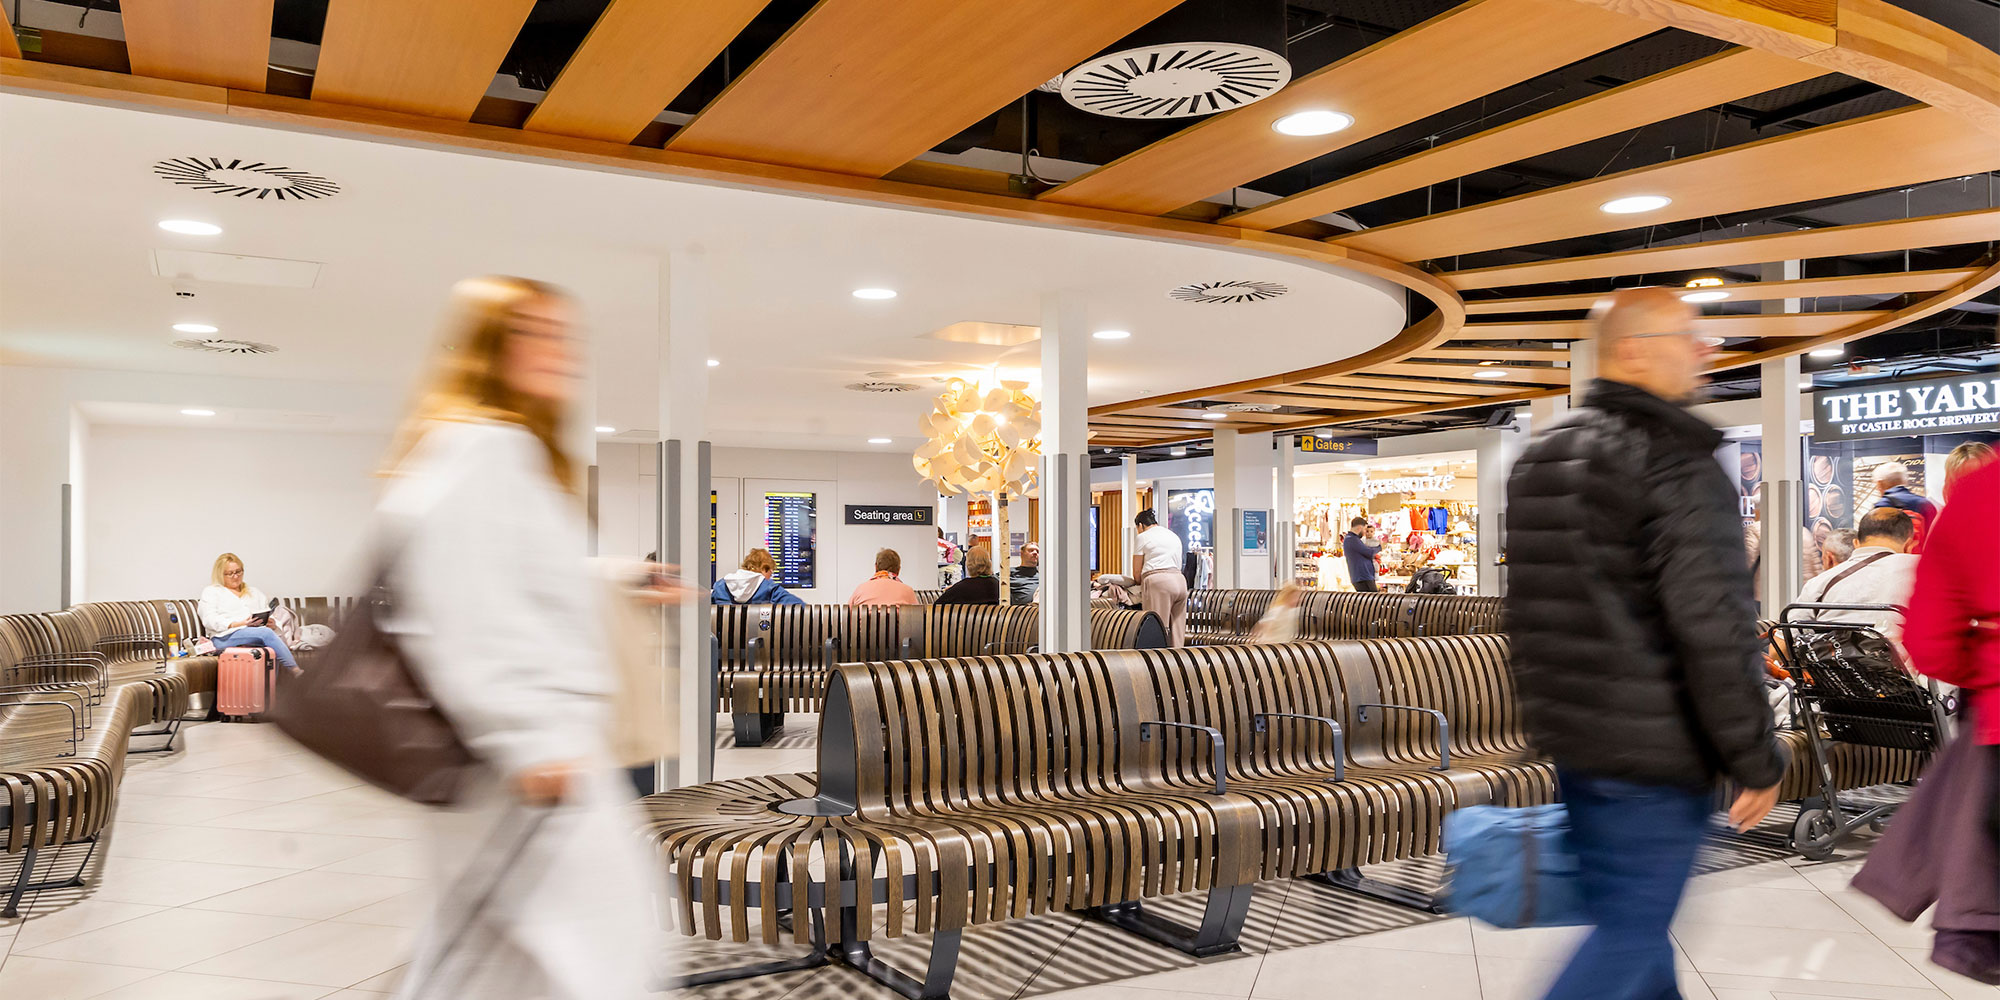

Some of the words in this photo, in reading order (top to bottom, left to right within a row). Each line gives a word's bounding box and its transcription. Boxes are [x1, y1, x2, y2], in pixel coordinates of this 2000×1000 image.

[1822, 389, 1902, 422] THE
[1842, 423, 1858, 434] BY
[1858, 419, 1901, 433] CASTLE
[1903, 416, 1937, 430] ROCK
[1938, 412, 2000, 427] BREWERY
[1315, 438, 1344, 451] Gates
[1357, 472, 1456, 500] Accessorize
[853, 509, 890, 522] Seating
[892, 512, 914, 521] area
